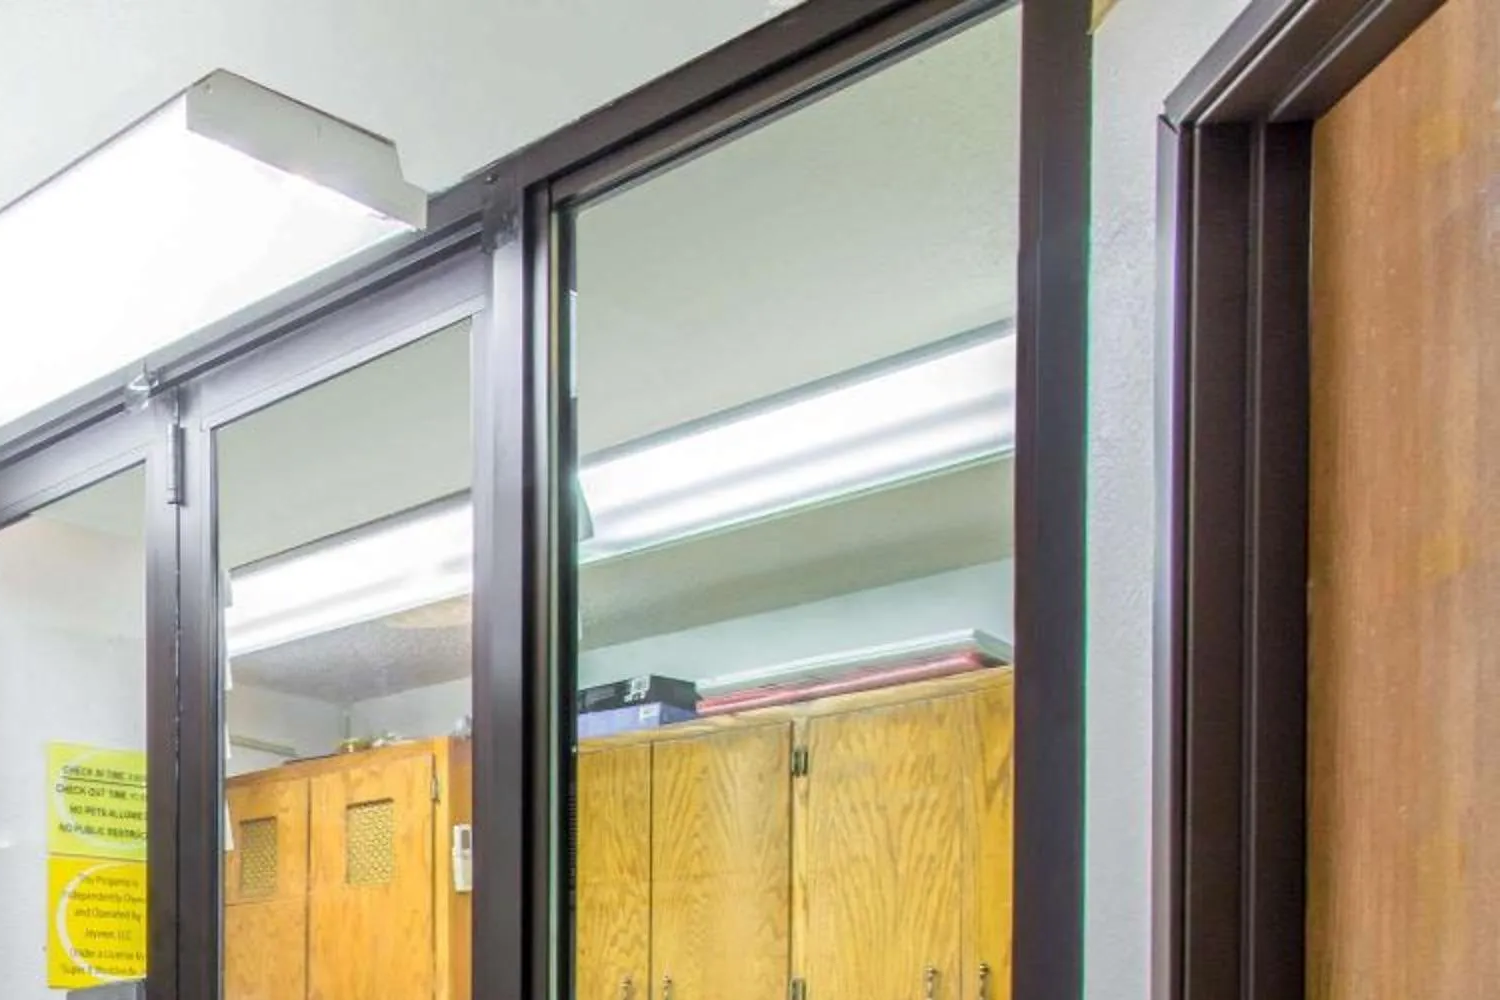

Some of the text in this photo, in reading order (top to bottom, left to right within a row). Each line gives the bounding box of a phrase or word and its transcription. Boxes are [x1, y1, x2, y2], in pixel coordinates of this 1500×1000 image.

[56, 783, 85, 795] CHECK
[87, 787, 105, 797] OUT
[108, 788, 126, 799] TIME
[70, 804, 83, 815] NO
[59, 822, 72, 832] NO
[73, 823, 105, 836] PUBLIC
